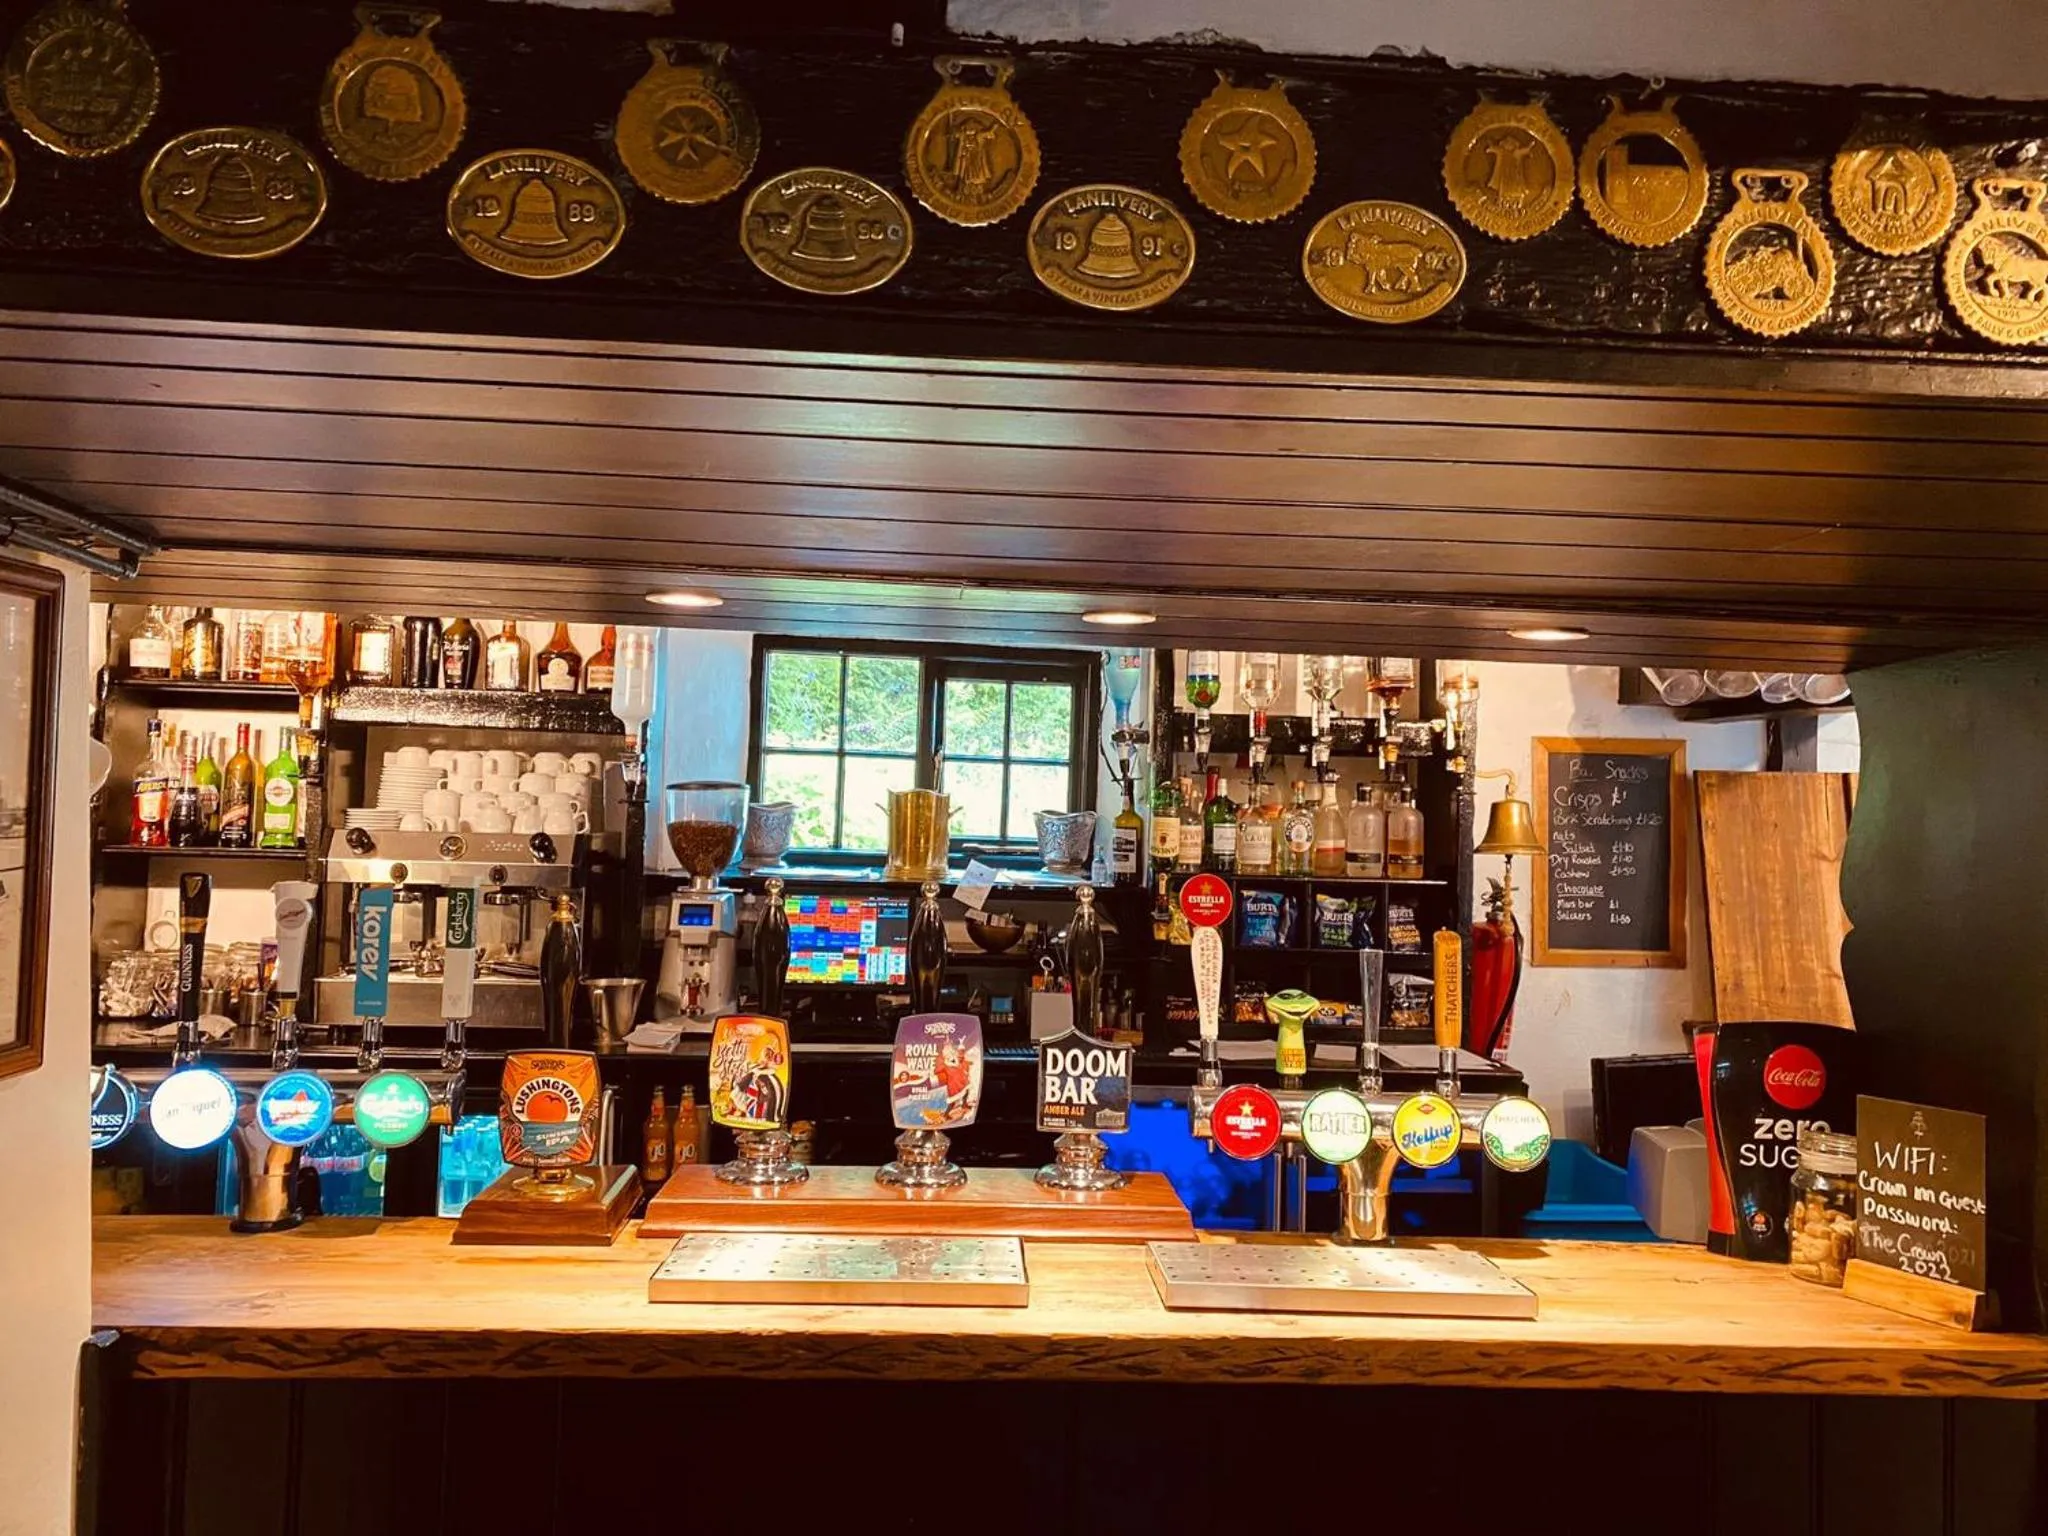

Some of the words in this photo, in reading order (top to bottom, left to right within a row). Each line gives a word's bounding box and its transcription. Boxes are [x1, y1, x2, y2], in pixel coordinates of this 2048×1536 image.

[485, 156, 592, 186] LANLIVERY
[568, 203, 596, 222] 89
[1063, 191, 1164, 222] LANLIVERY
[1055, 231, 1078, 250] 19
[1961, 216, 2048, 248] LANLIVER
[1142, 236, 1165, 257] 91
[1091, 290, 1142, 304] VINTAGE
[1975, 315, 2005, 338] RALLY
[1569, 759, 1593, 780] Ba
[1553, 785, 1602, 811] Crisps
[1549, 854, 1569, 869] Dry
[1188, 895, 1225, 904] ESTRELLA
[1556, 882, 1605, 895] Chocolate
[450, 892, 469, 945] Carlsberg
[1246, 902, 1278, 914] BURTS
[1322, 911, 1354, 923] BURTS
[360, 904, 388, 983] korev
[180, 943, 194, 993] GUINNESS
[1445, 953, 1459, 1025] THATCHERS
[905, 1043, 939, 1057] ROYAL
[907, 1057, 937, 1070] WAVE
[1045, 1047, 1127, 1078] DOOM
[1768, 1066, 1824, 1088] Coca-Cola
[515, 1078, 581, 1115] LUSHINGTONS
[1045, 1075, 1098, 1105] BAR
[91, 1113, 124, 1127] NESS
[1043, 1104, 1070, 1115] AMBER
[1070, 1105, 1086, 1116] ALE
[545, 1135, 571, 1147] IPA
[1753, 1117, 1832, 1142] zero
[1739, 1142, 1800, 1169] SUG
[1872, 1140, 1949, 1176] WIFI:
[1857, 1169, 1908, 1198] Crown
[1858, 1221, 1897, 1254] The
[1897, 1233, 1948, 1267] Crown
[1899, 1256, 1960, 1284] 2022
